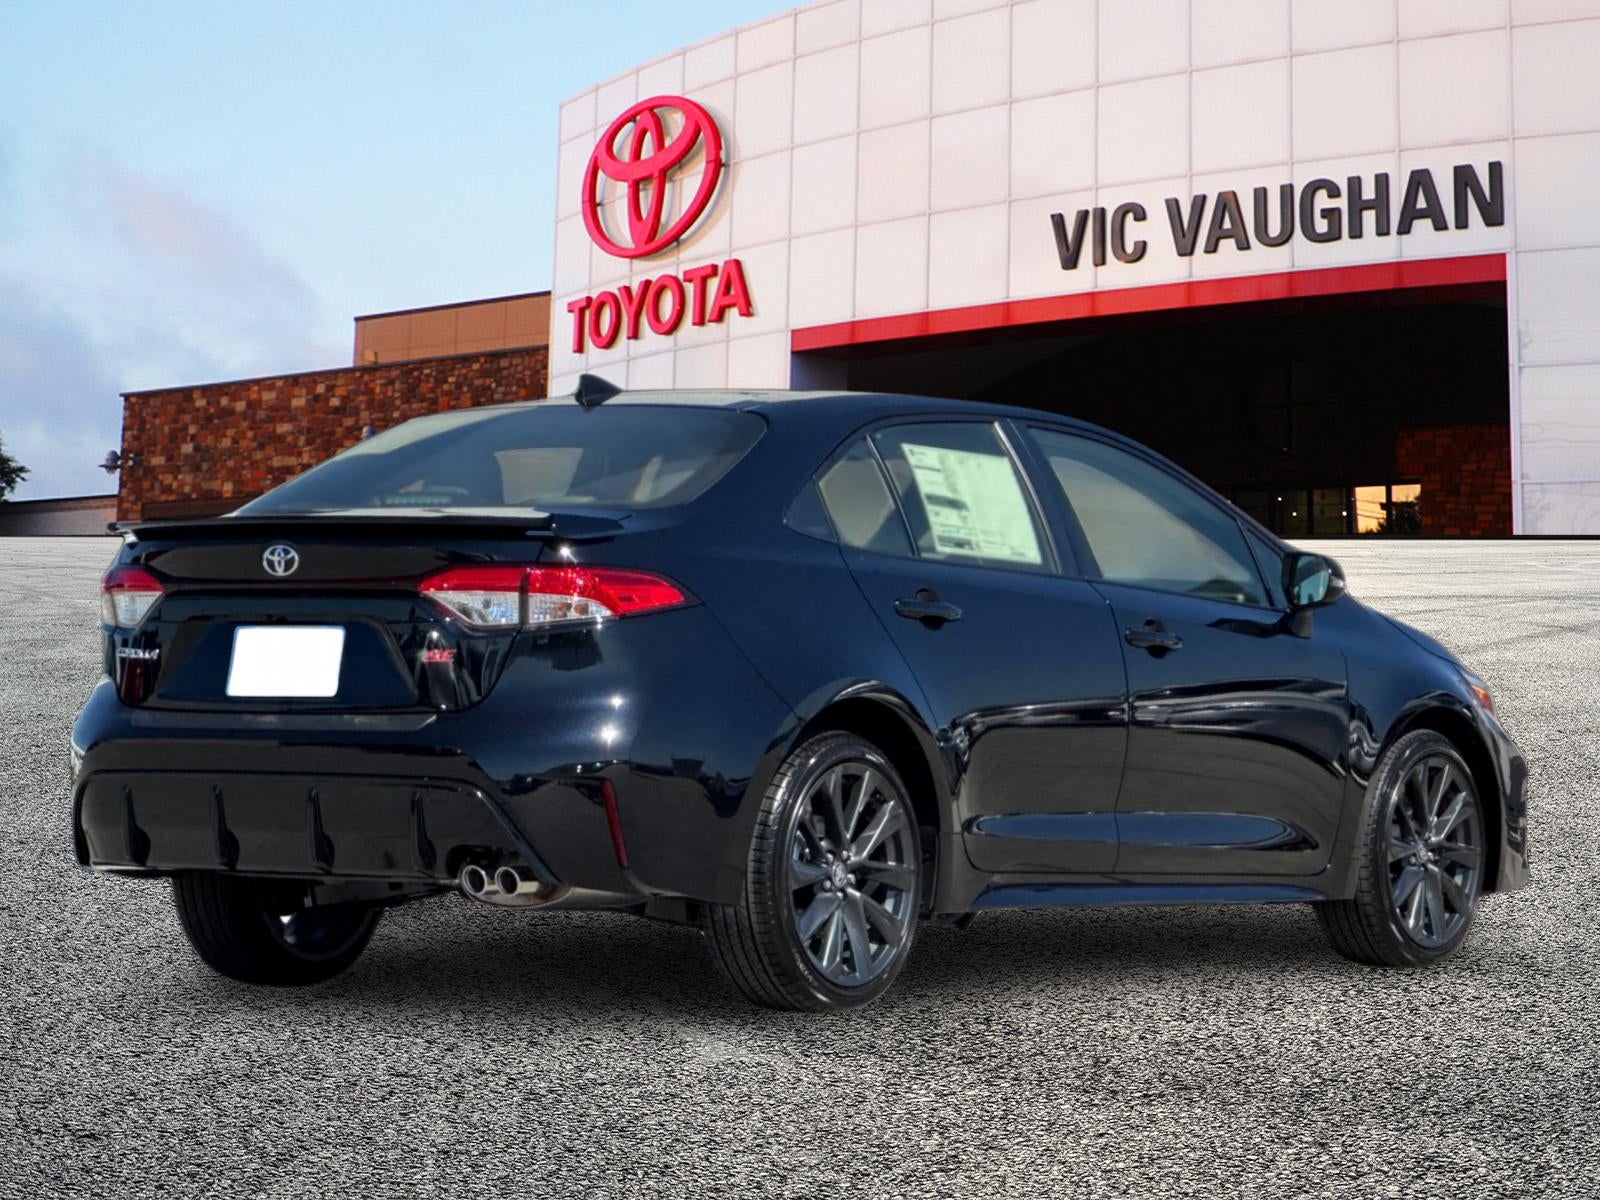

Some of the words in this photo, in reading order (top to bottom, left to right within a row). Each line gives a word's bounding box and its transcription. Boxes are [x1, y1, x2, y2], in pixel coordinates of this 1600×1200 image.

[1050, 201, 1147, 270] VIC
[1165, 161, 1504, 257] VAUGHAN
[567, 258, 753, 353] TOYOTA
